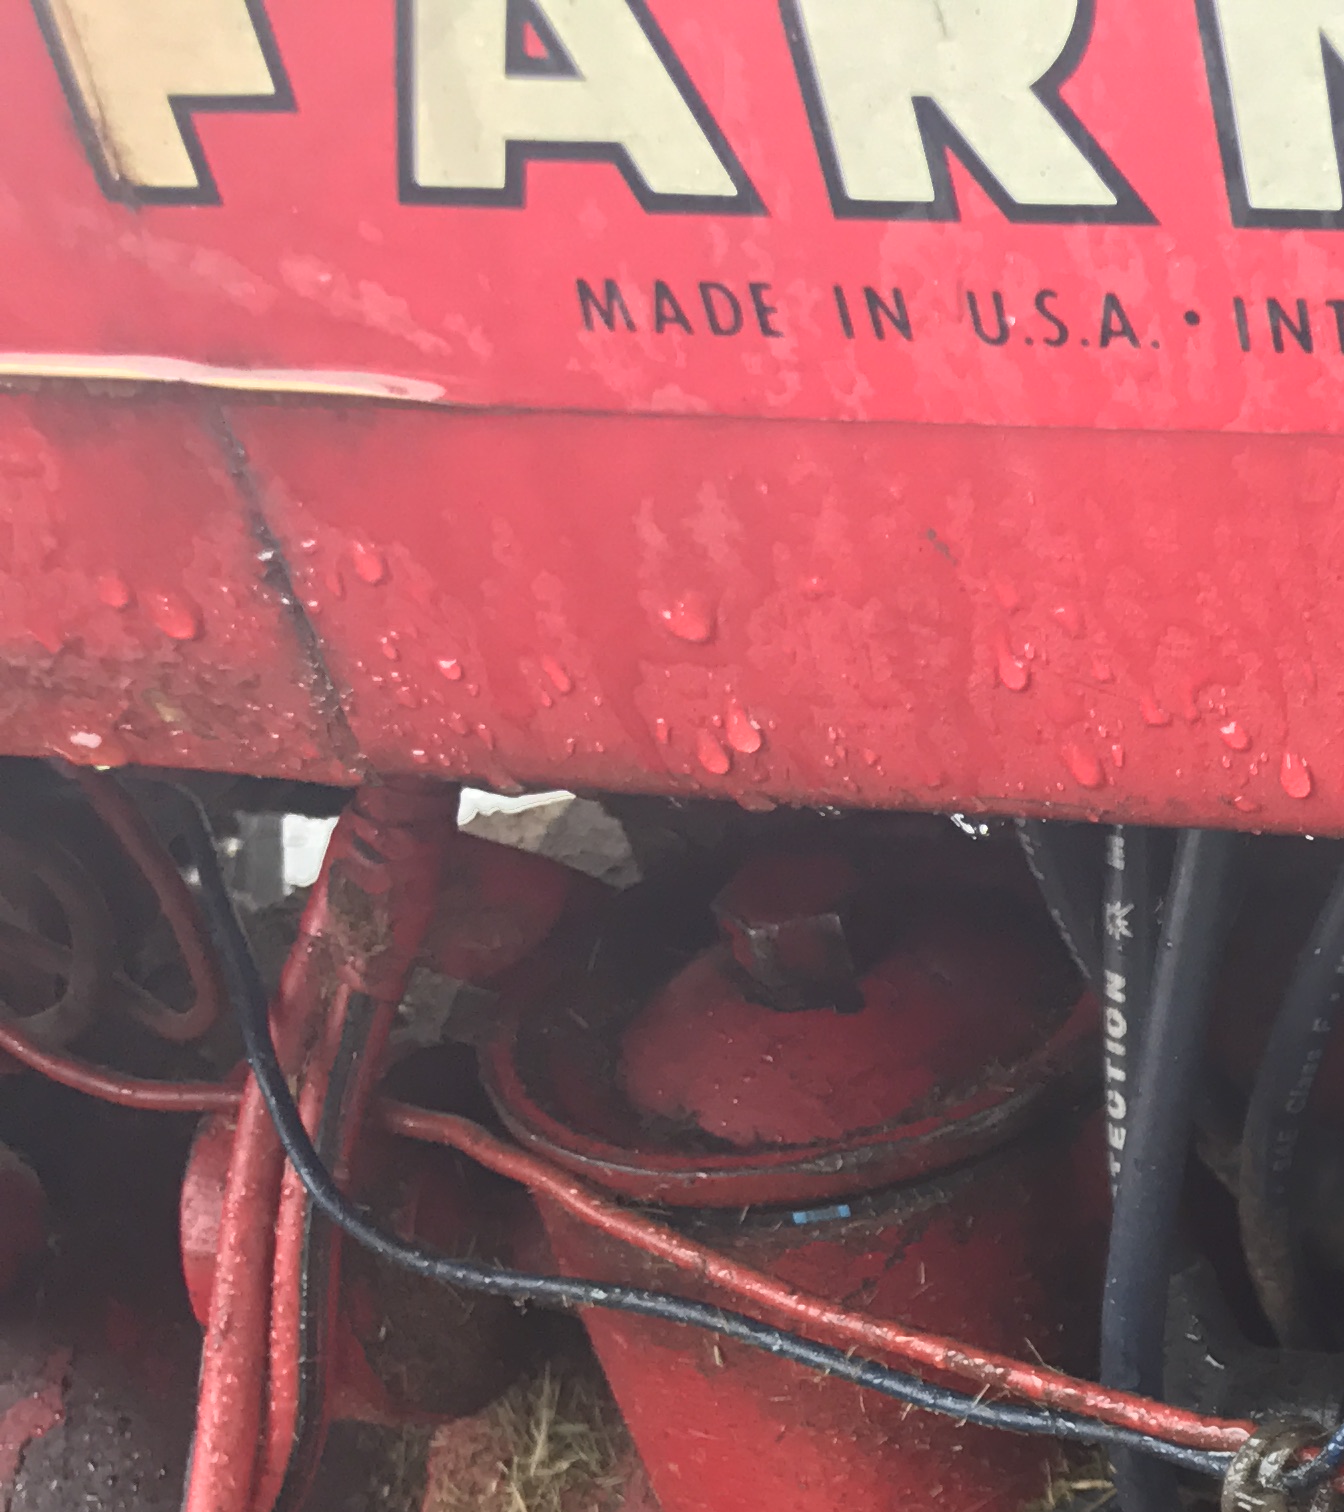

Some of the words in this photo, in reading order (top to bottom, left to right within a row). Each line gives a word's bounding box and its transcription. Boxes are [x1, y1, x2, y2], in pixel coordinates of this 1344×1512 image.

[575, 276, 780, 338] MADE
[833, 284, 912, 342] IN
[968, 288, 1161, 350] U.S.A.
